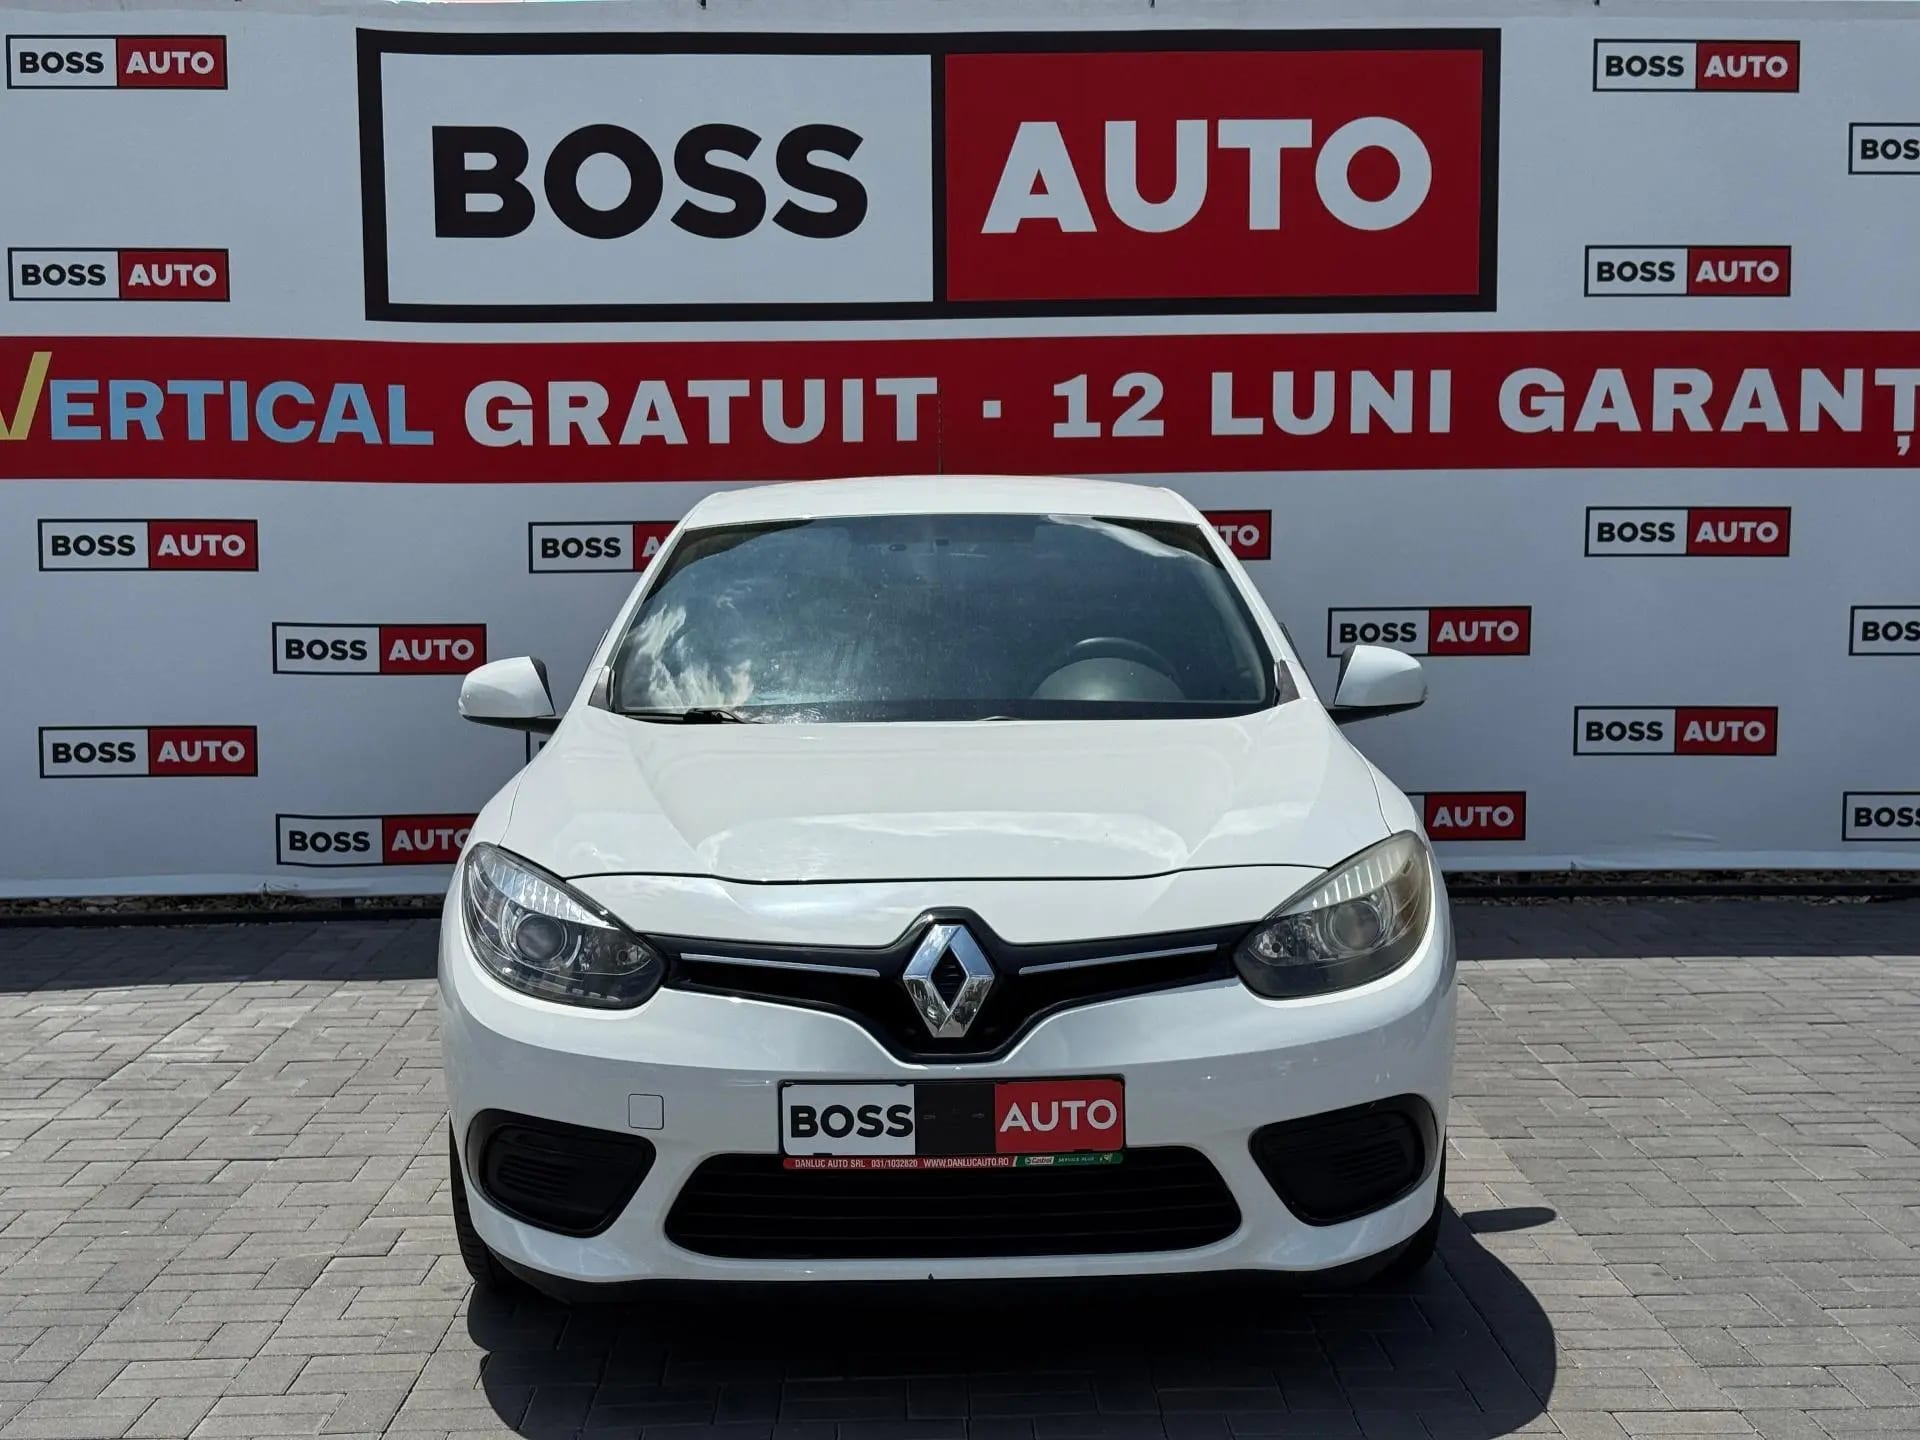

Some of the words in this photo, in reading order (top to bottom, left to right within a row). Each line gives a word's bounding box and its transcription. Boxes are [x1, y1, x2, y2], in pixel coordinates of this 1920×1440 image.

[20, 52, 104, 73] BOSS
[126, 52, 214, 74] AUTO
[1606, 56, 1684, 77] BOSS
[1704, 56, 1788, 77] AUTO
[432, 124, 867, 239] BOSS
[981, 117, 1432, 233] AUTO
[22, 264, 106, 286] BOSS
[129, 264, 216, 286] AUTO
[1597, 261, 1675, 282] BOSS
[1696, 261, 1779, 282] AUTO
[465, 377, 937, 447] GRATUIT
[1054, 373, 1164, 437] 12
[1212, 370, 1451, 435] LUNI
[1212, 525, 1260, 547] TO
[1598, 522, 1675, 542] BOSS
[1696, 522, 1778, 542] AUTO
[52, 535, 135, 556] BOSS
[158, 535, 245, 556] AUTO
[542, 537, 621, 558] BOSS
[1340, 623, 1416, 643] BOSS
[1437, 621, 1519, 642] AUTO
[286, 639, 367, 660] BOSS
[389, 639, 474, 660] AUTO
[1586, 721, 1663, 741] BOSS
[1683, 721, 1765, 742] AUTO
[53, 742, 136, 763] BOSS
[158, 741, 245, 762] AUTO
[1433, 806, 1514, 827] AUTO
[289, 831, 370, 852] BOSS
[791, 1104, 913, 1138] BOSS
[1000, 1100, 1117, 1132] AUTO
[795, 1158, 826, 1168] DANLUC
[828, 1158, 848, 1168] AUTO
[851, 1158, 866, 1168] SRL
[923, 1157, 1009, 1168] WWW.DANLUCAUTO.RO
